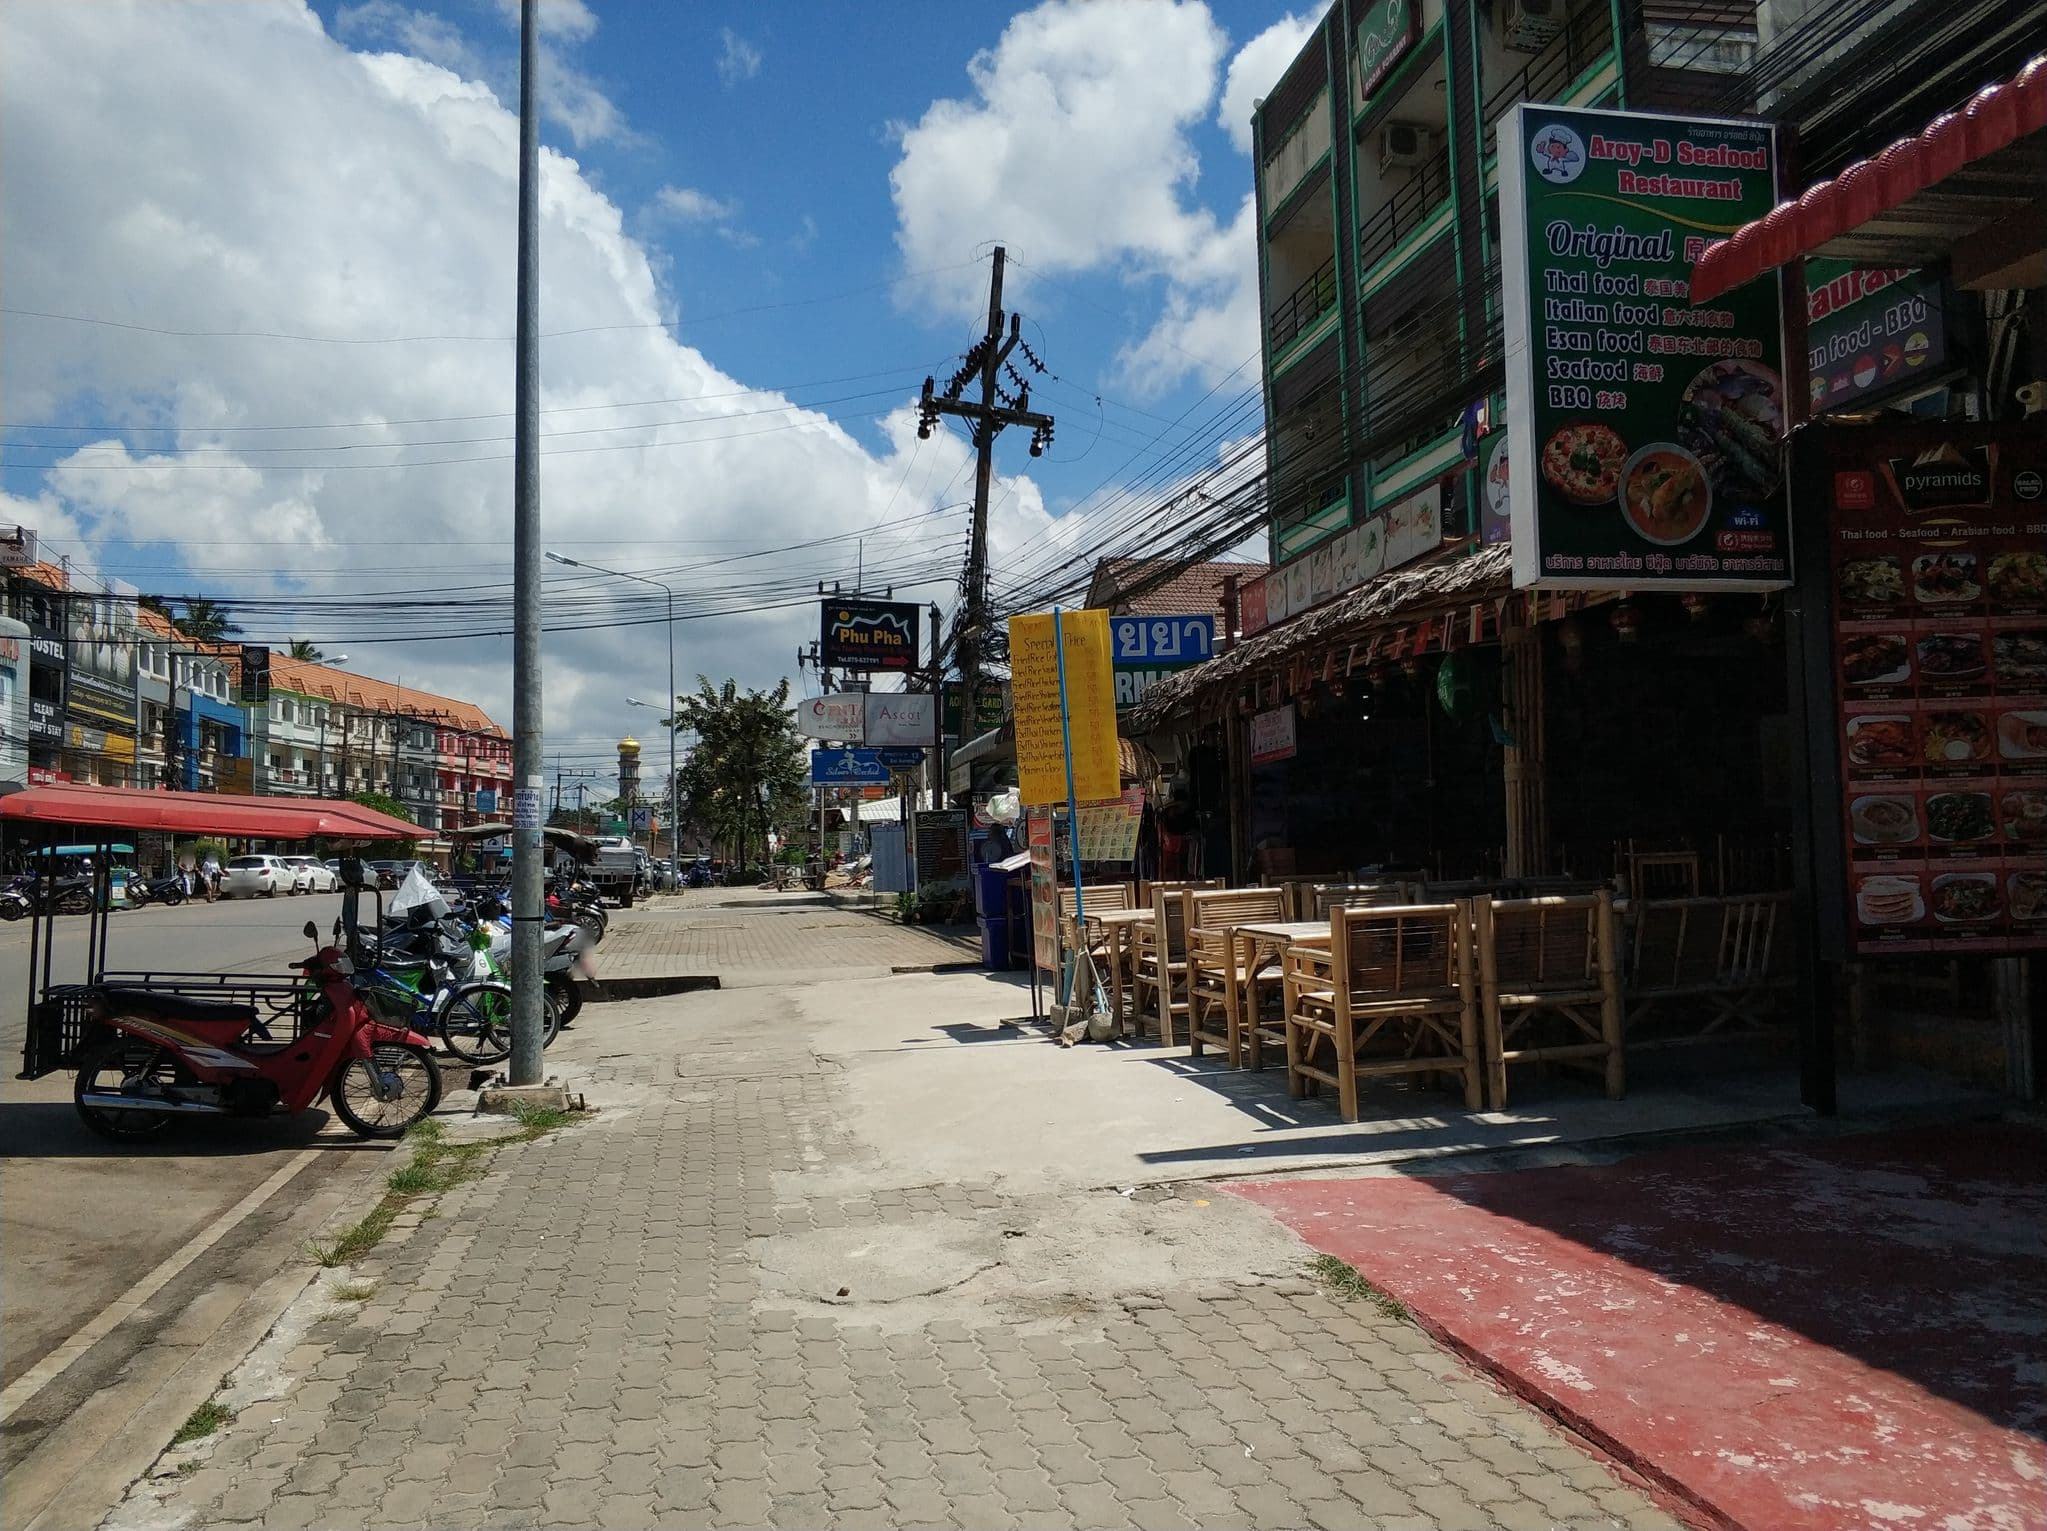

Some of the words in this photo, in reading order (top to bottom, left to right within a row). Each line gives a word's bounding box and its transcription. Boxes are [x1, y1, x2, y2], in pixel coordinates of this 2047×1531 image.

[1589, 135, 1671, 165] Aroy-D
[1677, 140, 1768, 169] Seafood
[1619, 170, 1743, 200] Restaurant
[1546, 220, 1674, 267] Original
[1545, 270, 1587, 293] Thai
[1594, 273, 1638, 295] food
[1545, 299, 1607, 323] Italian
[1614, 301, 1658, 324] food
[1546, 327, 1590, 351] Esan
[1597, 329, 1642, 352] food
[1829, 320, 1871, 362] food
[1886, 294, 1927, 336] BBQ
[1547, 356, 1627, 381] Seafood
[1633, 364, 1663, 382] 海鲜
[1549, 386, 1591, 409] BBQ
[1905, 472, 1982, 490] pyramids
[1841, 529, 1864, 540] Thai
[1866, 529, 1888, 539] food
[1899, 527, 1940, 538] Seafood
[1951, 526, 1989, 537] Arabian
[1993, 525, 2015, 535] food
[1587, 551, 1643, 570] อาหารไทย
[839, 628, 869, 644] Phu
[873, 630, 903, 645] Pha
[1110, 620, 1208, 657] ยยา
[33, 702, 54, 717] CLEAN
[879, 706, 921, 720] Ascot
[47, 724, 62, 737] STAY
